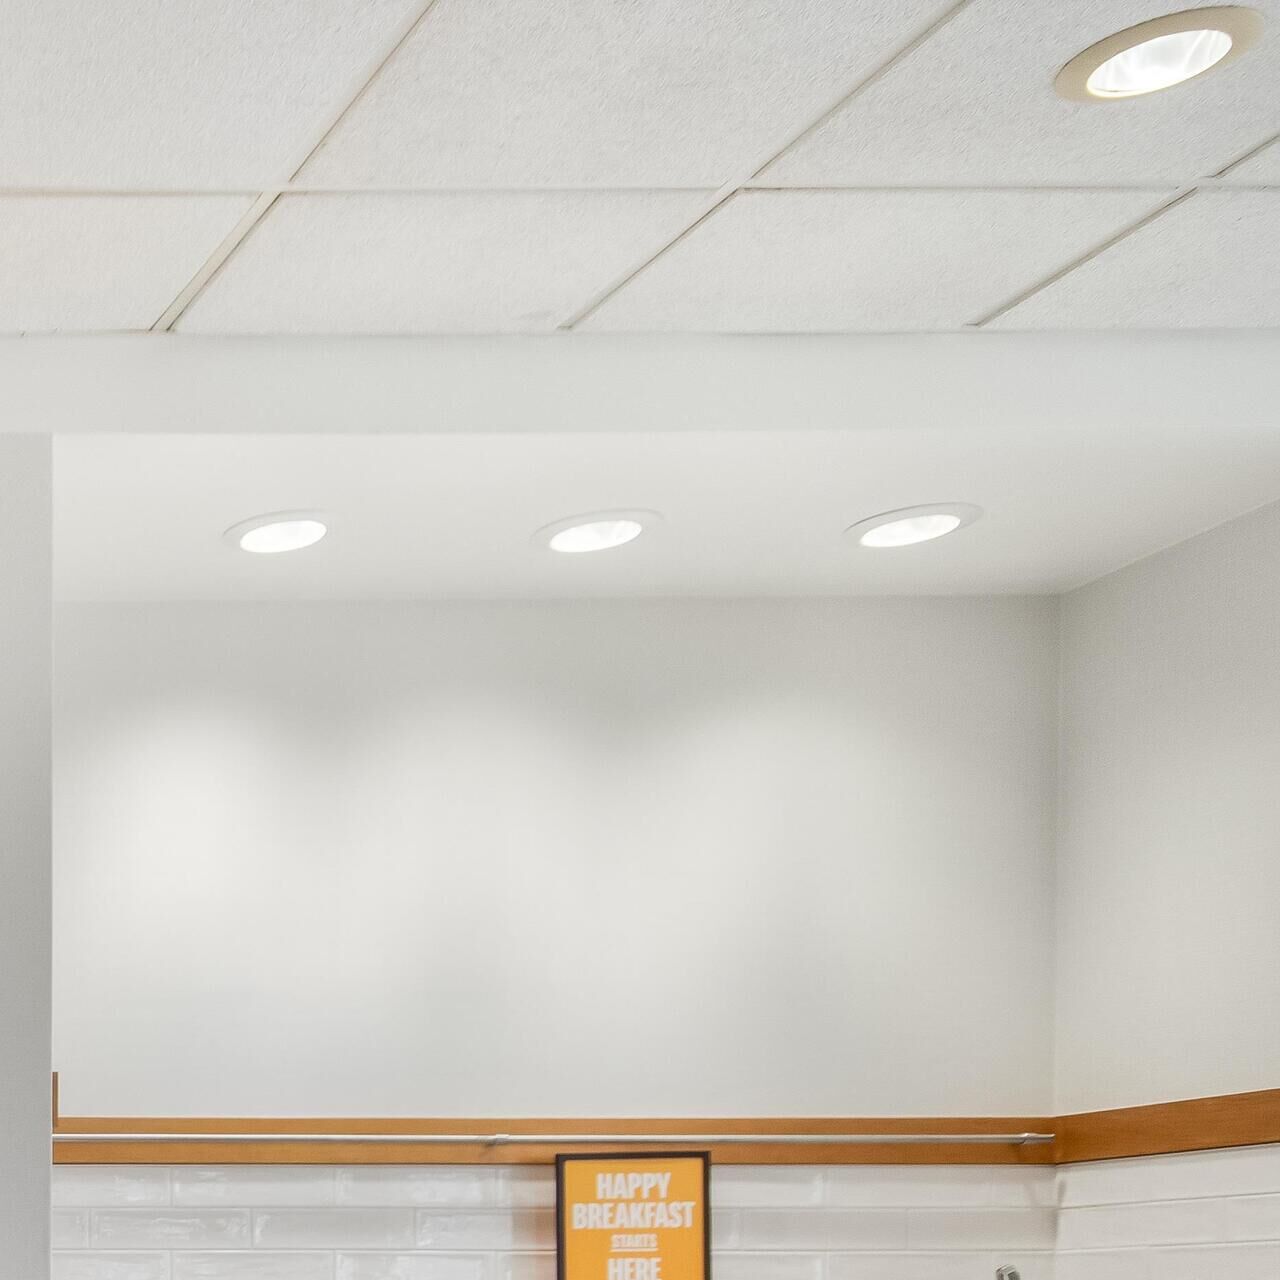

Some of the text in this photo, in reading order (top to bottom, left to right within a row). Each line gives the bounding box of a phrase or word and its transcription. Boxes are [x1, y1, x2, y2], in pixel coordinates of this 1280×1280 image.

[596, 1172, 671, 1200] HAPPY
[572, 1201, 696, 1229] BREAKFAST
[611, 1233, 657, 1248] STARTS
